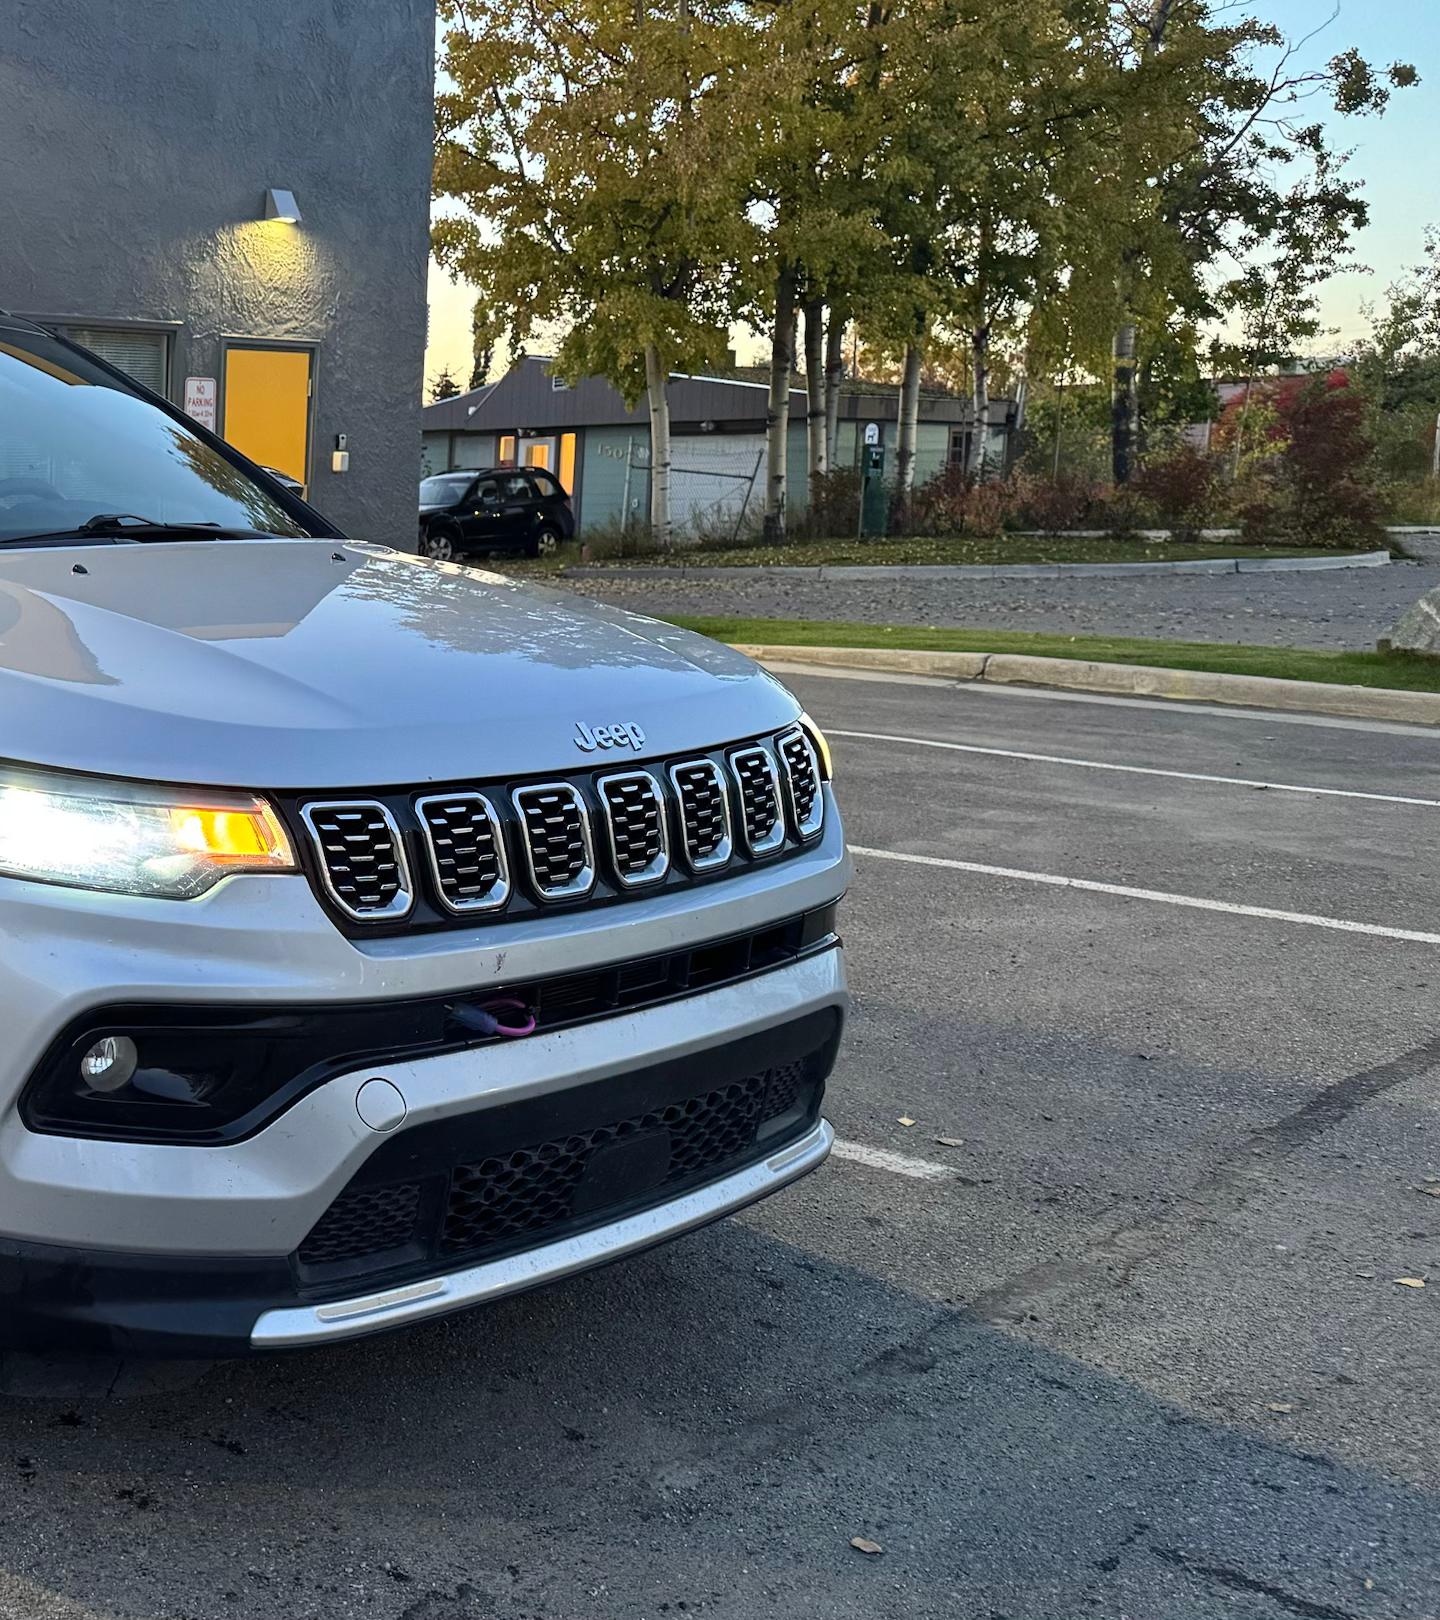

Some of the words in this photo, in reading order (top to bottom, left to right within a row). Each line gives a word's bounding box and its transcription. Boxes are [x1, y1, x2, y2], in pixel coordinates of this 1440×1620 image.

[196, 385, 205, 395] NO
[188, 397, 213, 407] PARKING
[573, 721, 646, 752] Jeep
